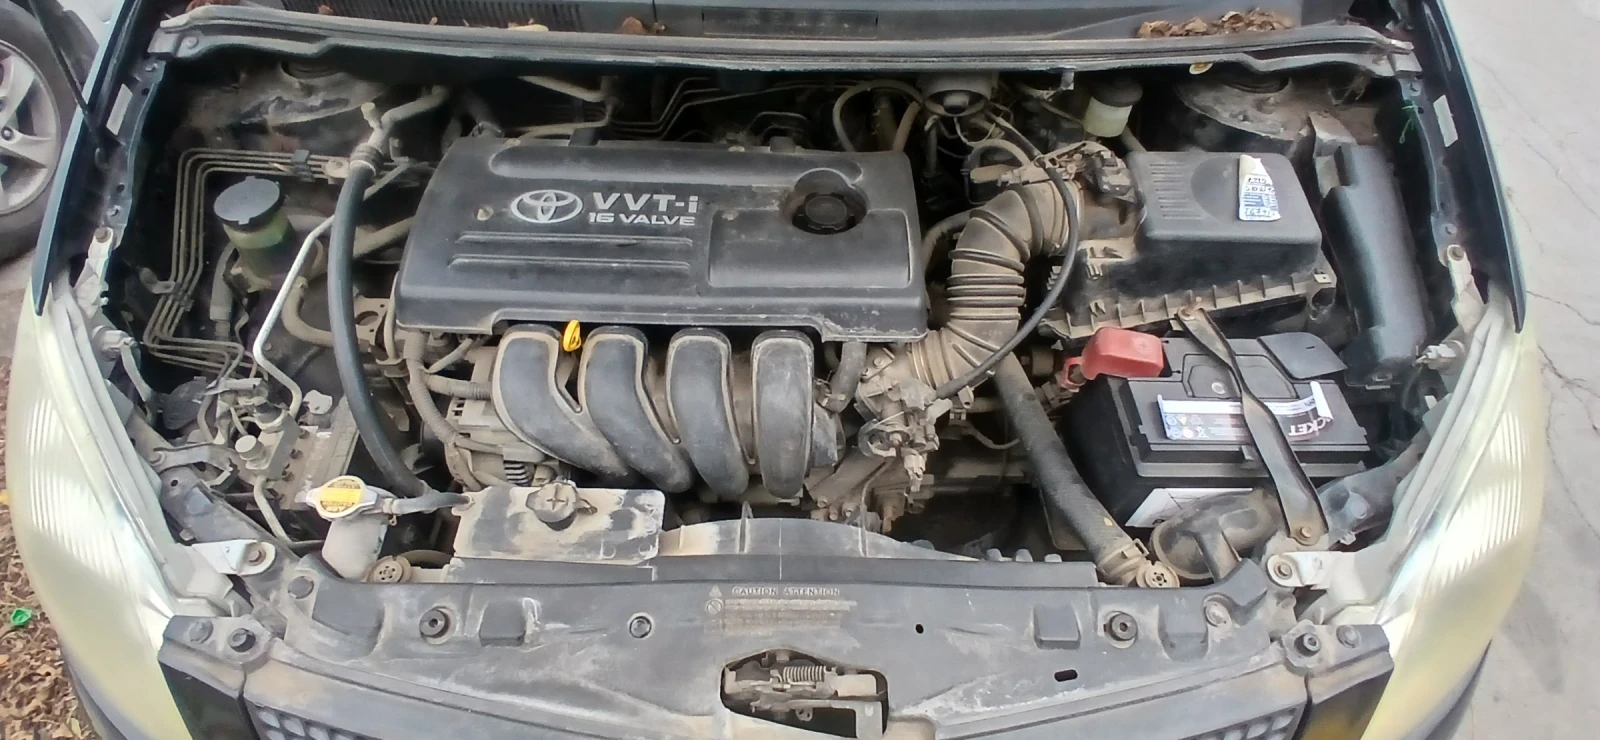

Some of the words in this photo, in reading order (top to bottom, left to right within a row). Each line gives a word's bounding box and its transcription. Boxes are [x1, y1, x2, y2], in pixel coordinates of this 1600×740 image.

[593, 192, 699, 213] VVT-i
[589, 212, 615, 223] 16
[619, 213, 696, 226] VALVE
[1288, 417, 1331, 437] CKET
[731, 586, 778, 596] CAUTION
[783, 586, 840, 596] ATTENTION
